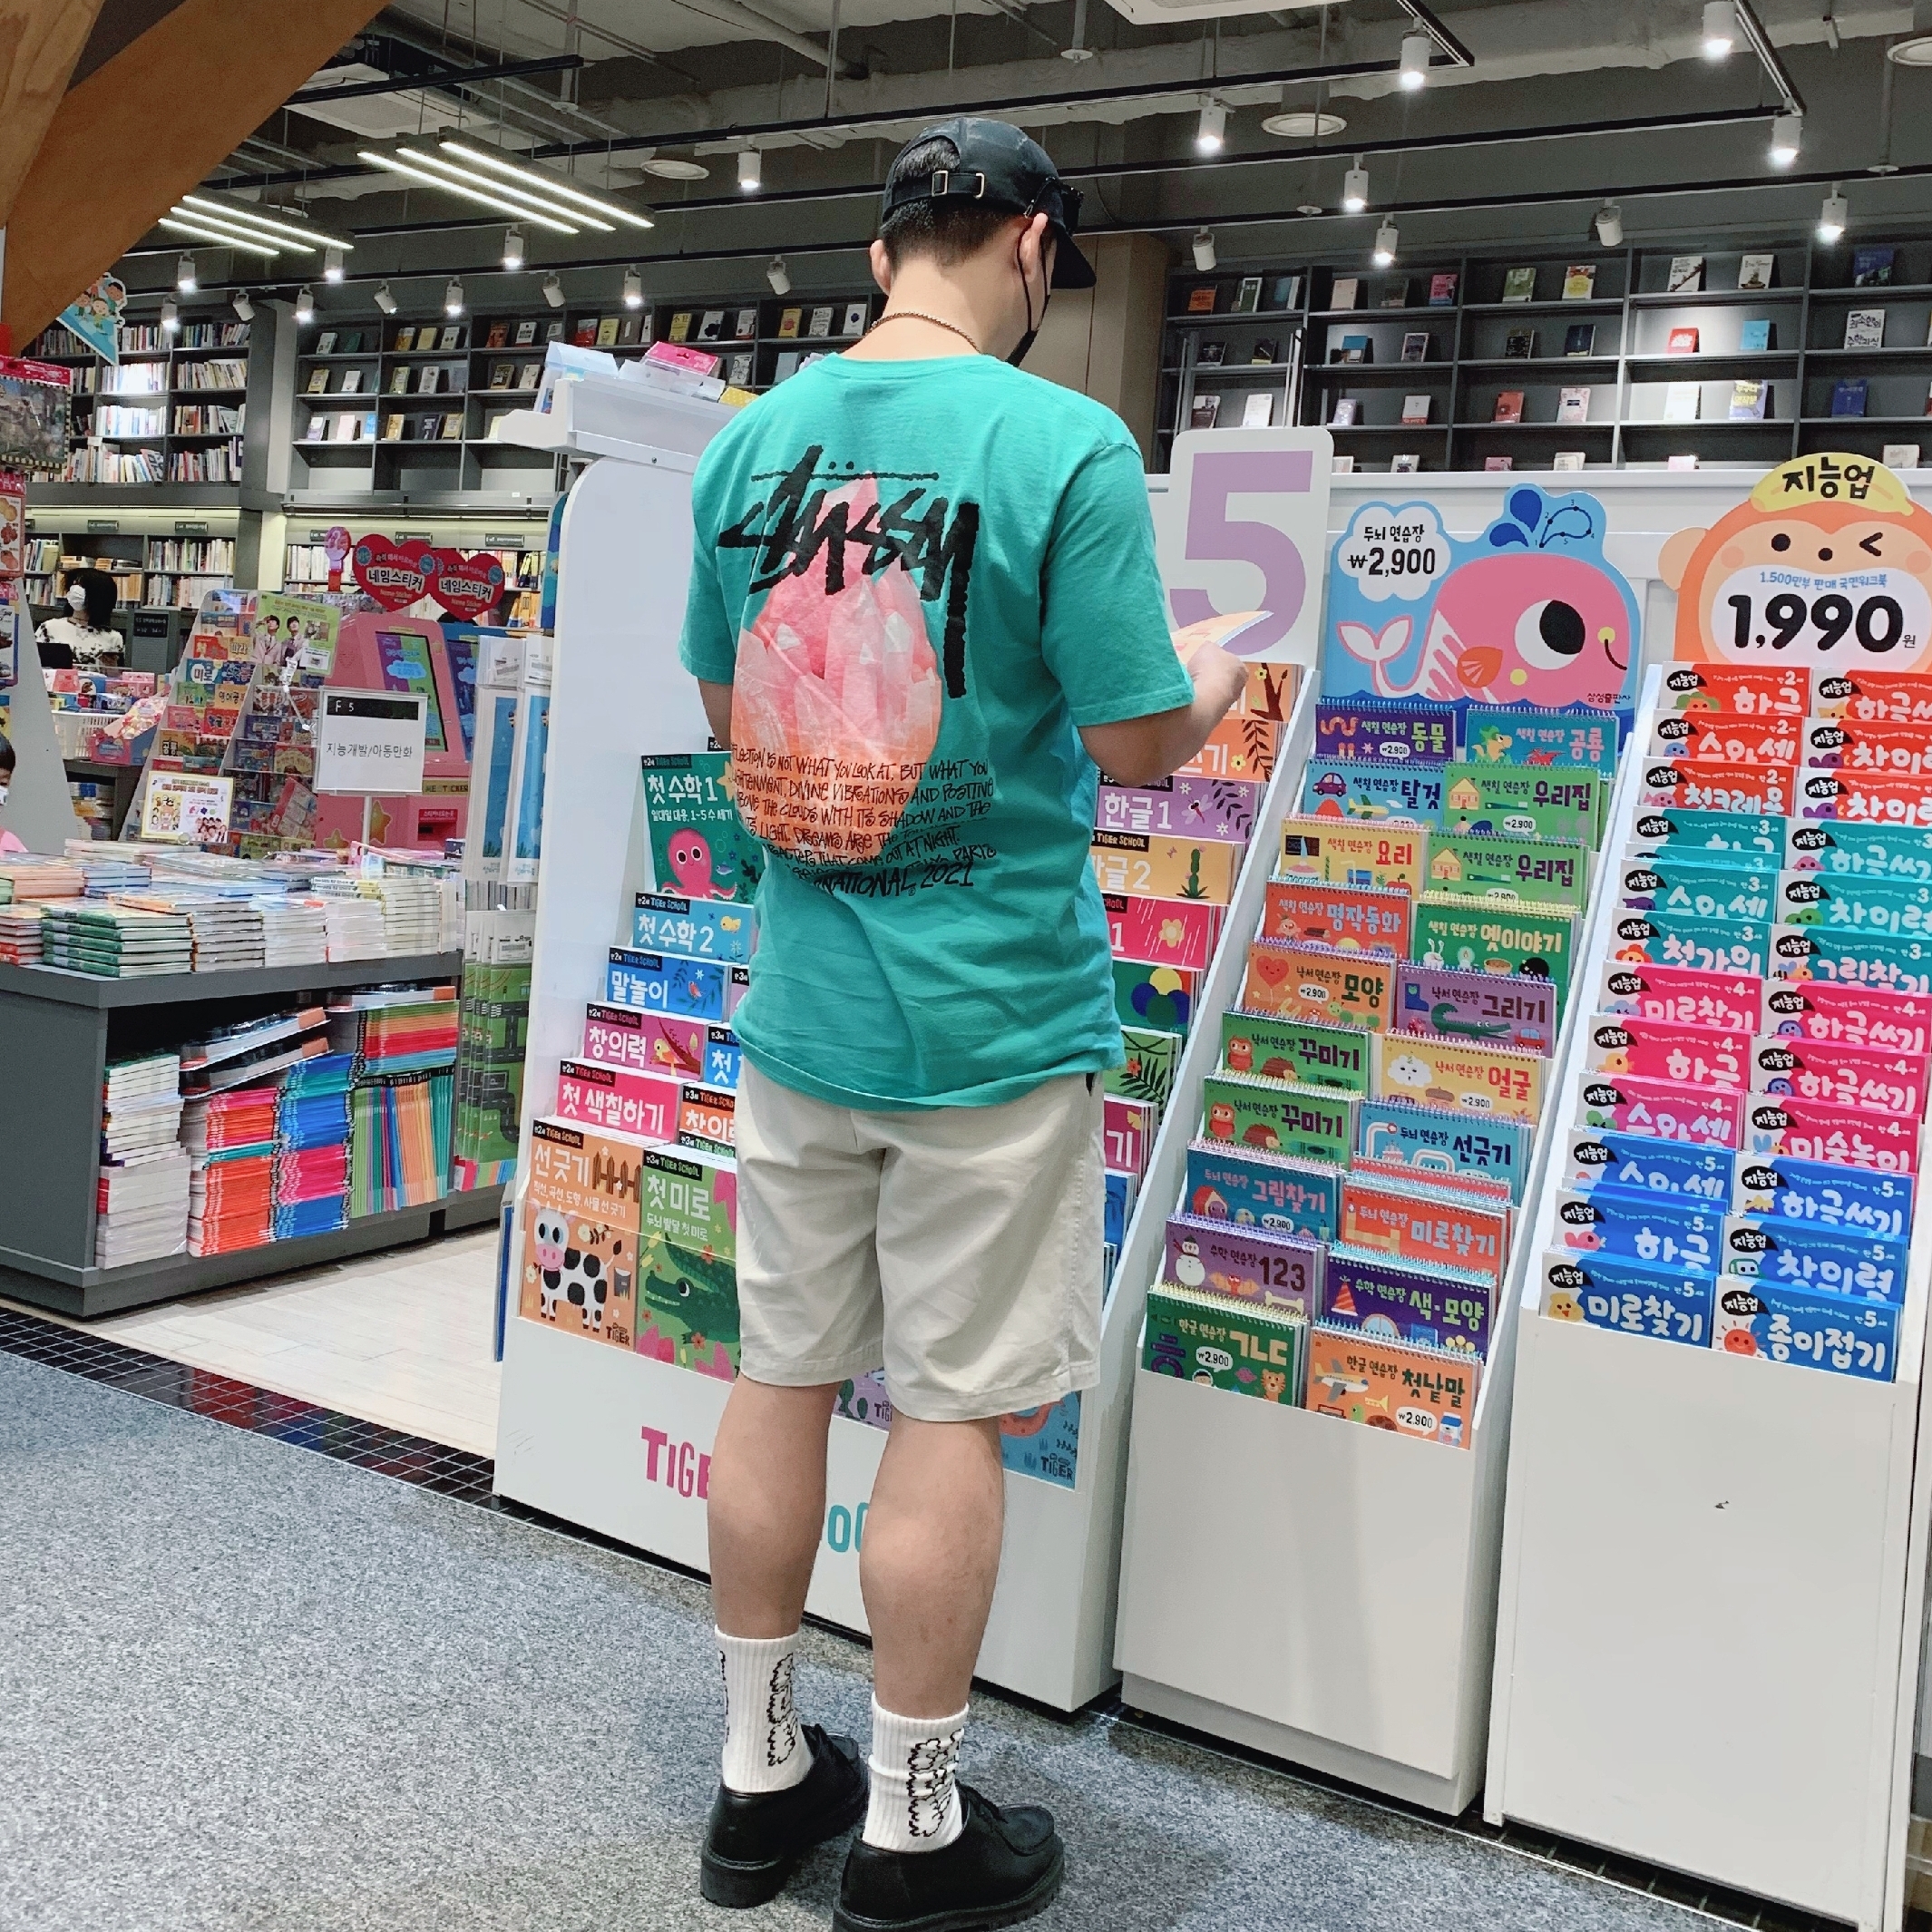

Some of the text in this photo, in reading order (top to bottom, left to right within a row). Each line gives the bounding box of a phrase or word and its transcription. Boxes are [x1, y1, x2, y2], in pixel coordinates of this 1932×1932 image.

[1782, 456, 1875, 500] 지능업
[1364, 524, 1424, 542] 두뇌 연습장
[368, 569, 423, 591] 네임스티커
[441, 580, 493, 600] 네임스티커
[1814, 579, 1837, 590] 판매
[1839, 573, 1888, 590] 국민워크북
[1821, 680, 1852, 696] 지능업
[336, 700, 342, 713] F
[1361, 720, 1447, 754] 색칠 연습장 동물
[1516, 727, 1605, 763] 색칠 연습장 공룡
[778, 756, 795, 771] NOT
[796, 756, 834, 776] WHAT
[901, 763, 927, 780] BUT
[929, 759, 970, 780] WHAT
[648, 774, 718, 805] 첫 수학 1
[911, 786, 940, 805] AND
[1352, 776, 1441, 811] 색칠 연습장 탈것
[1480, 779, 1591, 812] 색칠 연습장 우리집
[708, 809, 716, 821] 수
[780, 803, 817, 823] CLOUDS
[821, 805, 854, 827] WITH
[878, 807, 935, 828] SHADOW
[938, 806, 966, 822] AND
[1105, 792, 1172, 831] 한글 1
[1327, 838, 1413, 865] 색칠 연습장 요리
[921, 860, 973, 888] 2021
[1133, 861, 1151, 891] 2
[1462, 852, 1575, 887] 색칠 연습장 우리집
[638, 913, 715, 953] 첫 수학 2
[1279, 898, 1401, 934] 색칠 연습장 명작동화
[1428, 921, 1562, 954] 색칠 연습장 옛이야기
[611, 971, 668, 1010] 말놀이
[1296, 966, 1384, 1008] 낙서 연습장 모양
[1431, 986, 1546, 1023] 낙서 연습장 그리기
[589, 1026, 647, 1068] 창의력
[1251, 1033, 1360, 1071] 낙서 연습장 꾸미기
[711, 1049, 732, 1084] 첫
[1435, 1060, 1533, 1102] 낙서 연습장 얼굴
[562, 1082, 665, 1135] 첫 색칠하기
[1234, 1099, 1343, 1138] 낙서 연습장 꾸미기
[1400, 1126, 1512, 1166] 두뇌 연습장 선긋기
[647, 1175, 711, 1223] 첫 미로
[1204, 1169, 1326, 1214] 두뇌 연습장 그림찾기
[1359, 1206, 1497, 1257] 두뇌 연습장 미로찾기
[1210, 1244, 1306, 1292] 수학 연습장 123
[1551, 1268, 1584, 1285] 지능업
[1355, 1280, 1375, 1294] 수학
[1377, 1283, 1407, 1302] 연습장
[1724, 1293, 1758, 1312] 지능업
[1179, 1319, 1197, 1333] 한글
[1198, 1322, 1226, 1342] 연습장
[1587, 1293, 1703, 1342] 미로찾기
[1767, 1314, 1886, 1373] 종이접기
[1346, 1356, 1367, 1374] 한글
[1369, 1359, 1399, 1380] 연습장
[640, 1425, 710, 1500] TIGE
